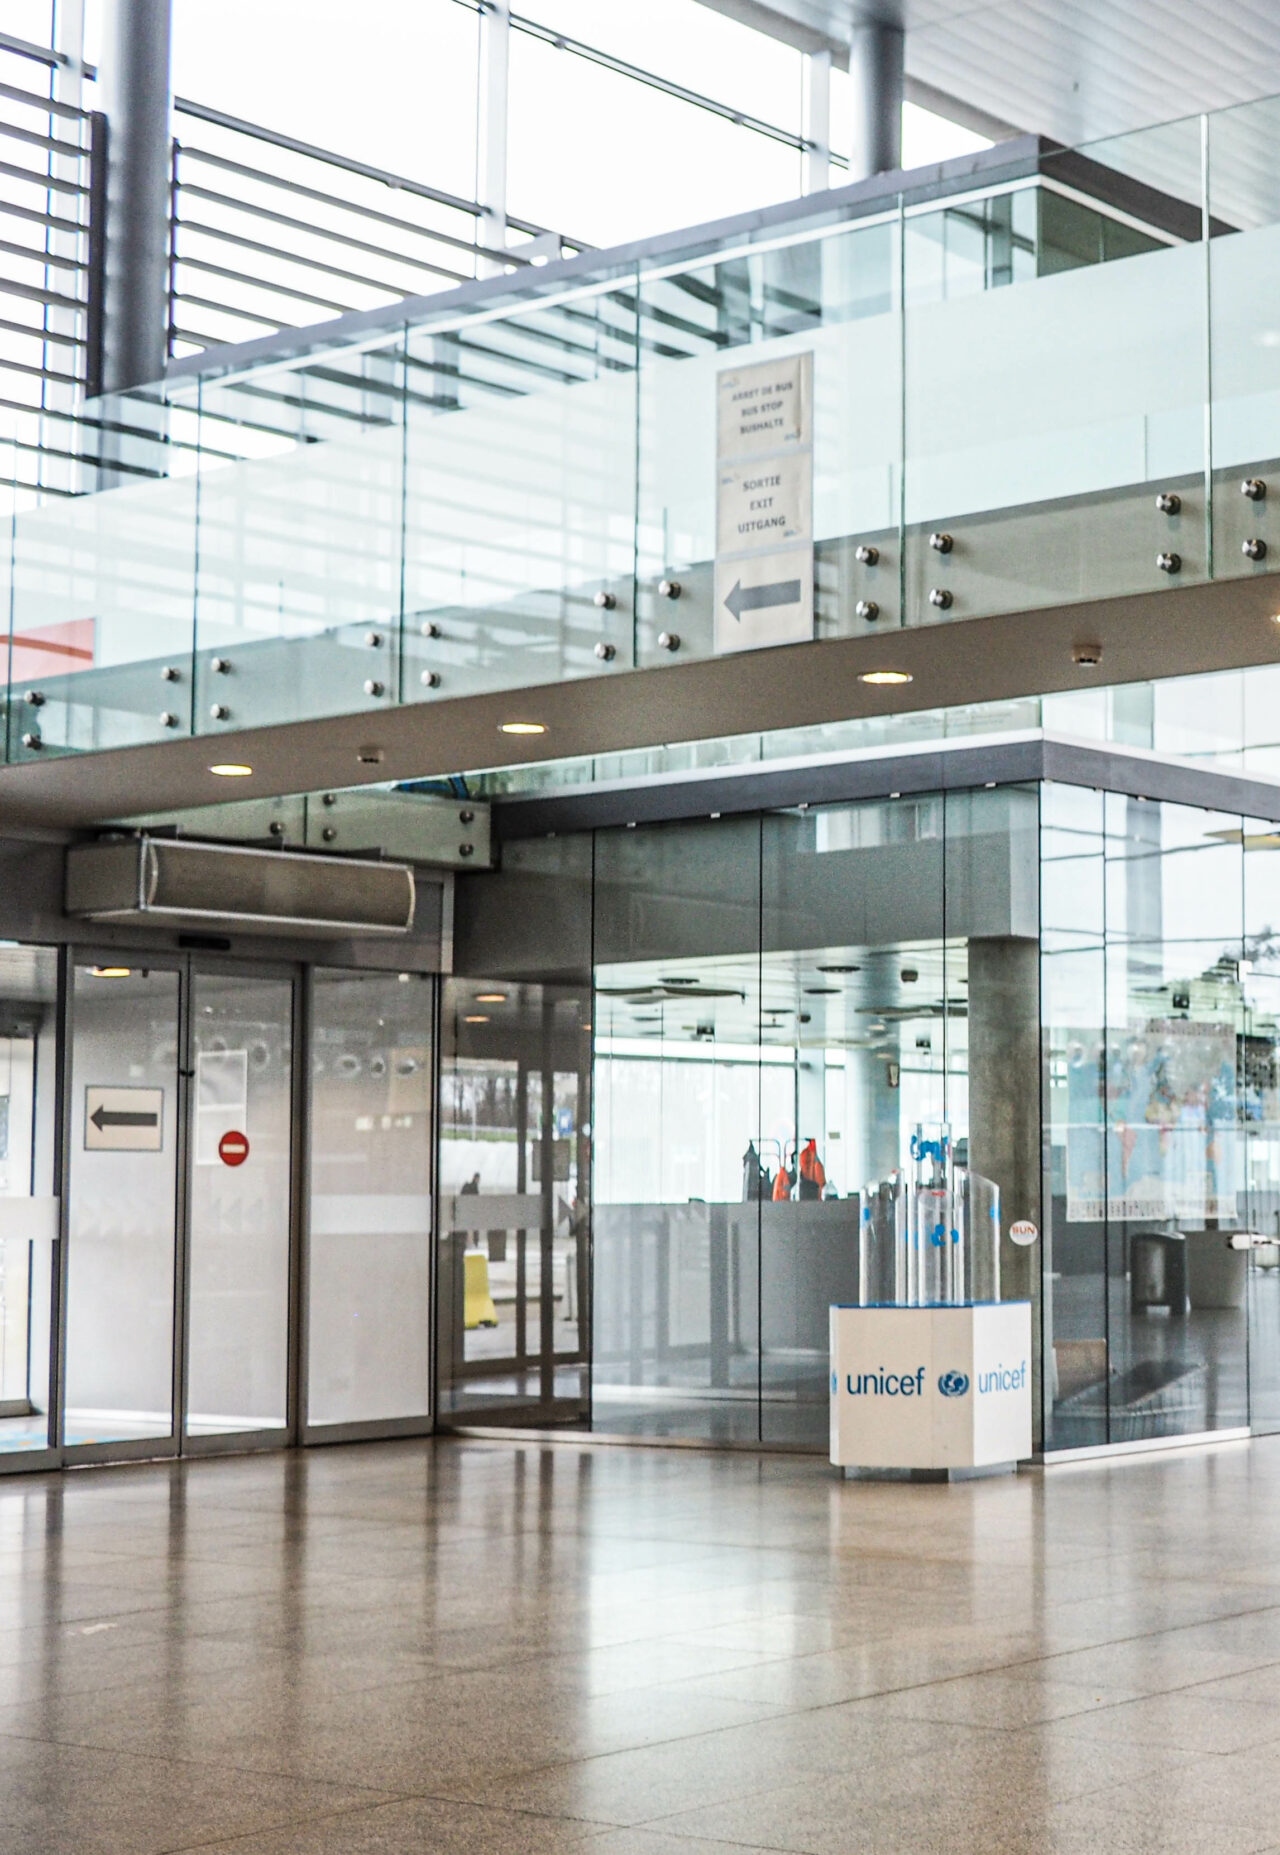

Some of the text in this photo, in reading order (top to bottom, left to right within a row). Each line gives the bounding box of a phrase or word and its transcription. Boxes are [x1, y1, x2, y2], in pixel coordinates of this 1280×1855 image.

[775, 382, 793, 392] BUS
[741, 400, 783, 417] BUS STOP
[740, 418, 783, 435] BUSHALTE
[743, 475, 781, 492] SORTIE
[750, 497, 773, 511] EXIT
[738, 515, 786, 534] UITGANG
[846, 1366, 926, 1396] unicef
[978, 1359, 1027, 1394] unicef
